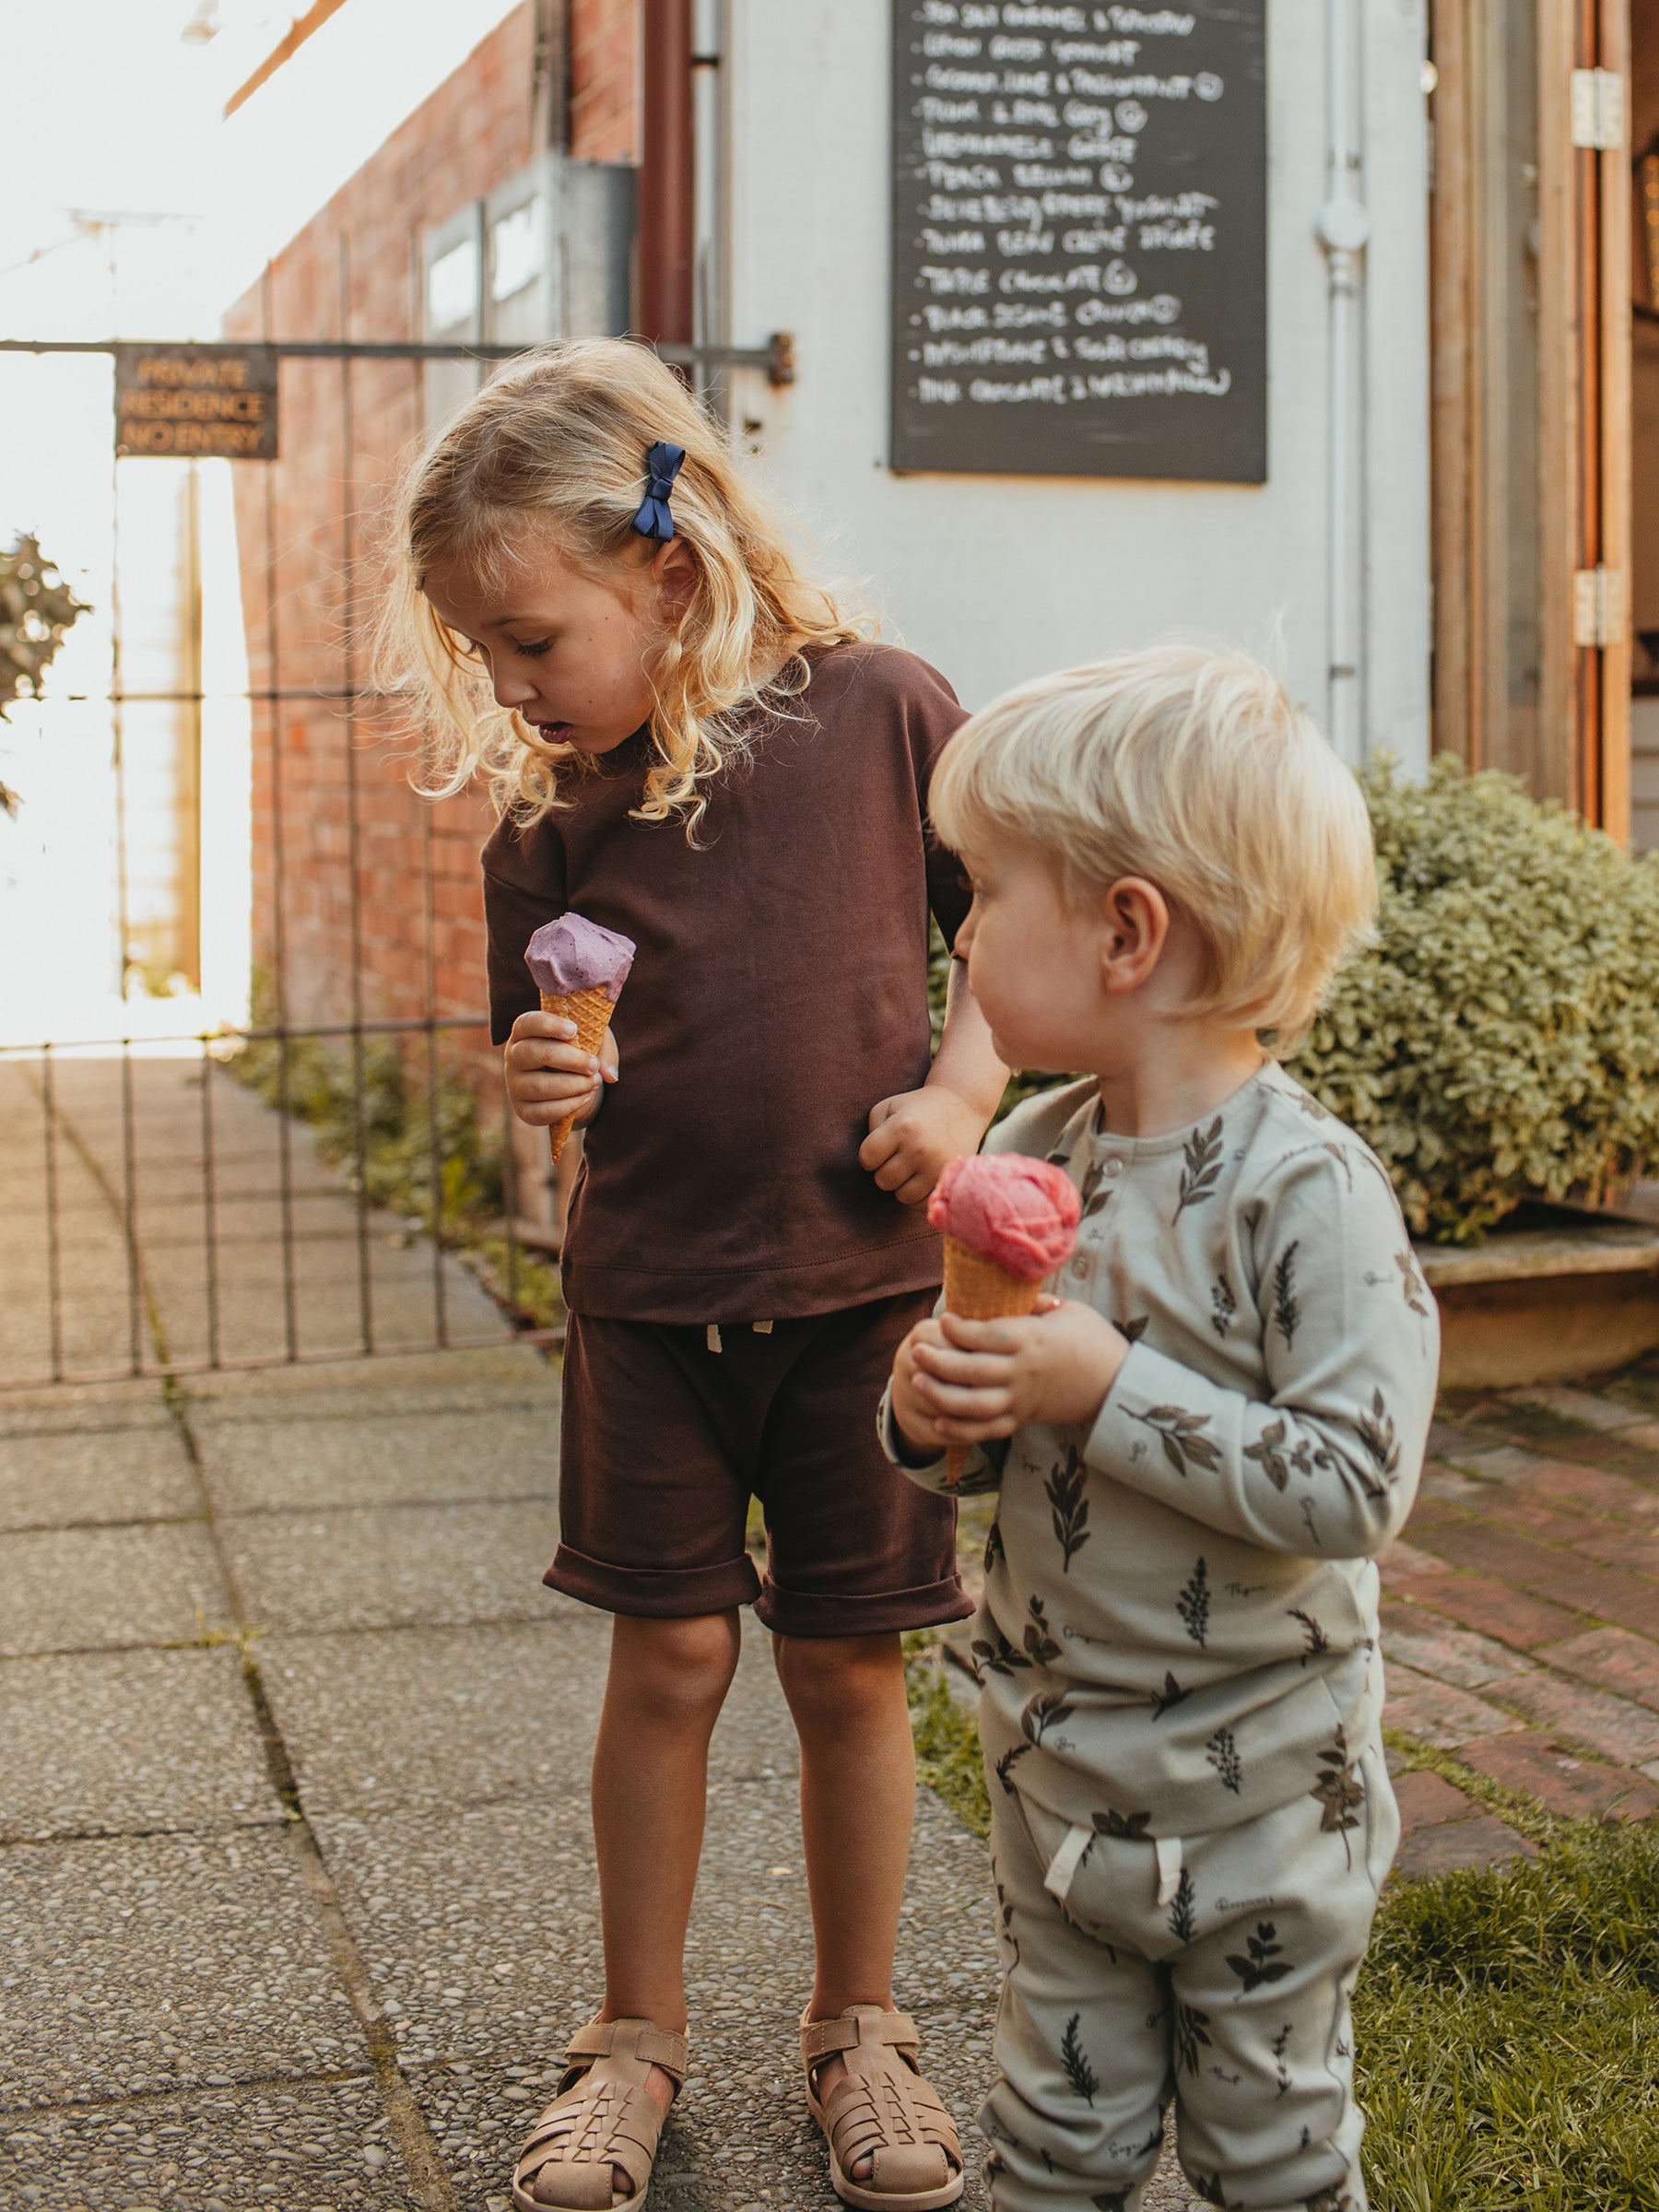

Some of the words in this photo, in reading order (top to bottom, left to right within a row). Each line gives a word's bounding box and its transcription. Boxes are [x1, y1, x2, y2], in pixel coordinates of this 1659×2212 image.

[924, 160, 1001, 190] PEACH
[996, 229, 1054, 257] BEAN
[139, 359, 249, 386] PRIVATE
[124, 391, 265, 419] RESIDENCE
[124, 421, 172, 450] NO
[176, 422, 265, 451] ENTRY
